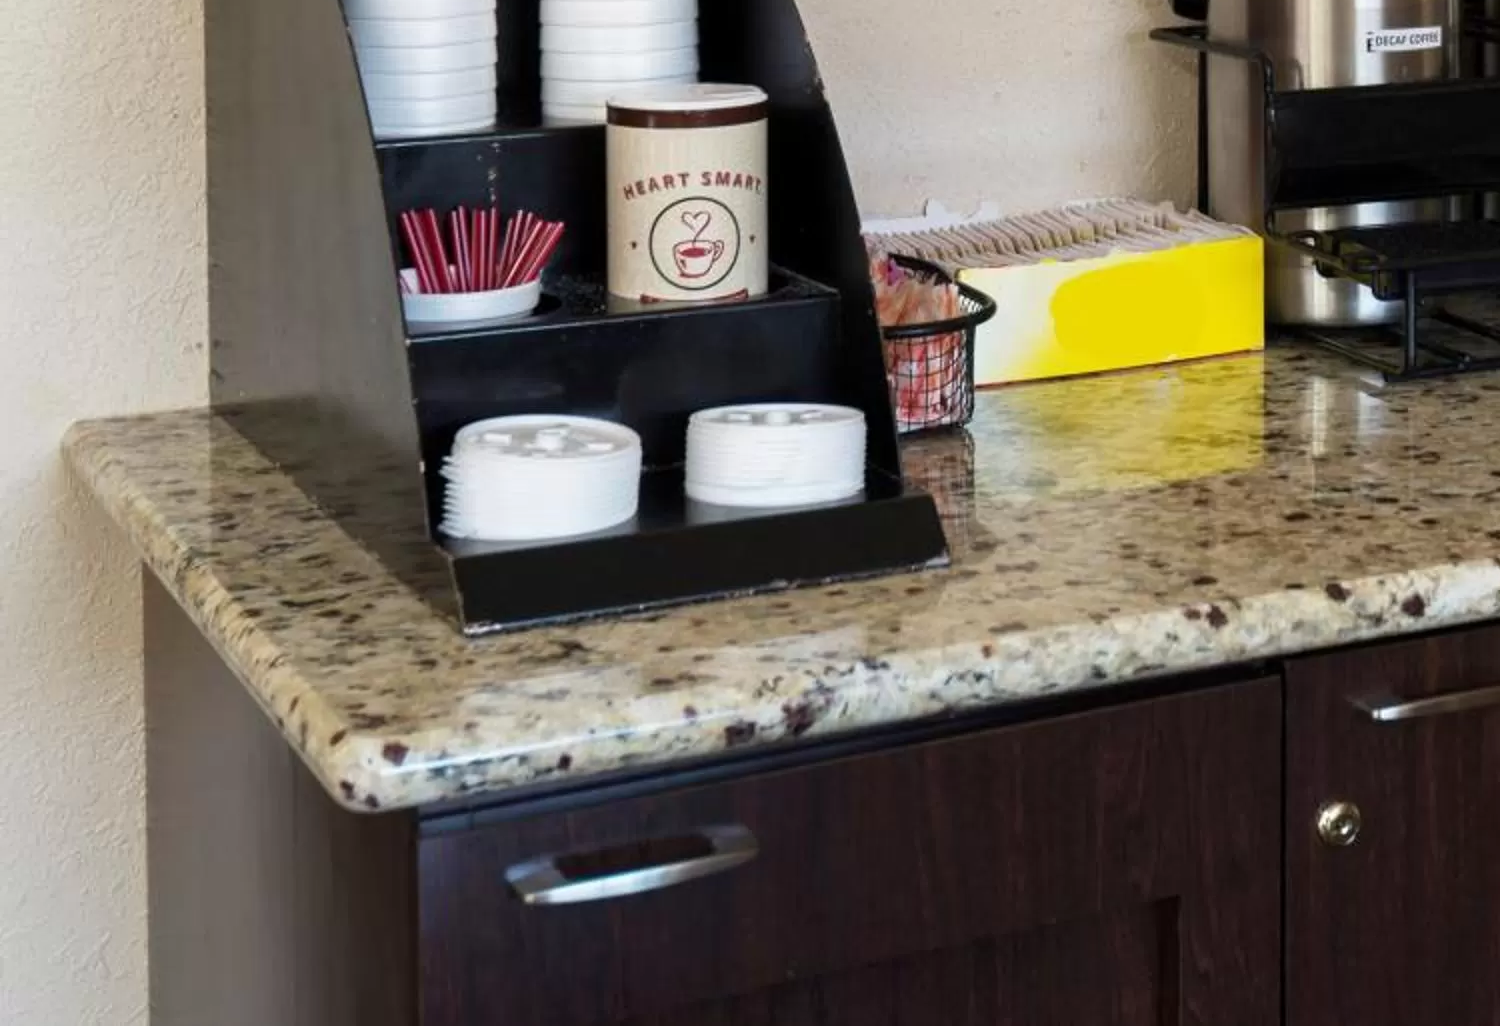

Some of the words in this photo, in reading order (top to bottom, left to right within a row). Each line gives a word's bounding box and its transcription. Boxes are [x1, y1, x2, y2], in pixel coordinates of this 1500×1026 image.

[1375, 34, 1407, 47] DECAF
[1409, 29, 1439, 46] COFFEE
[623, 172, 690, 201] HEART
[701, 171, 762, 195] SMART
